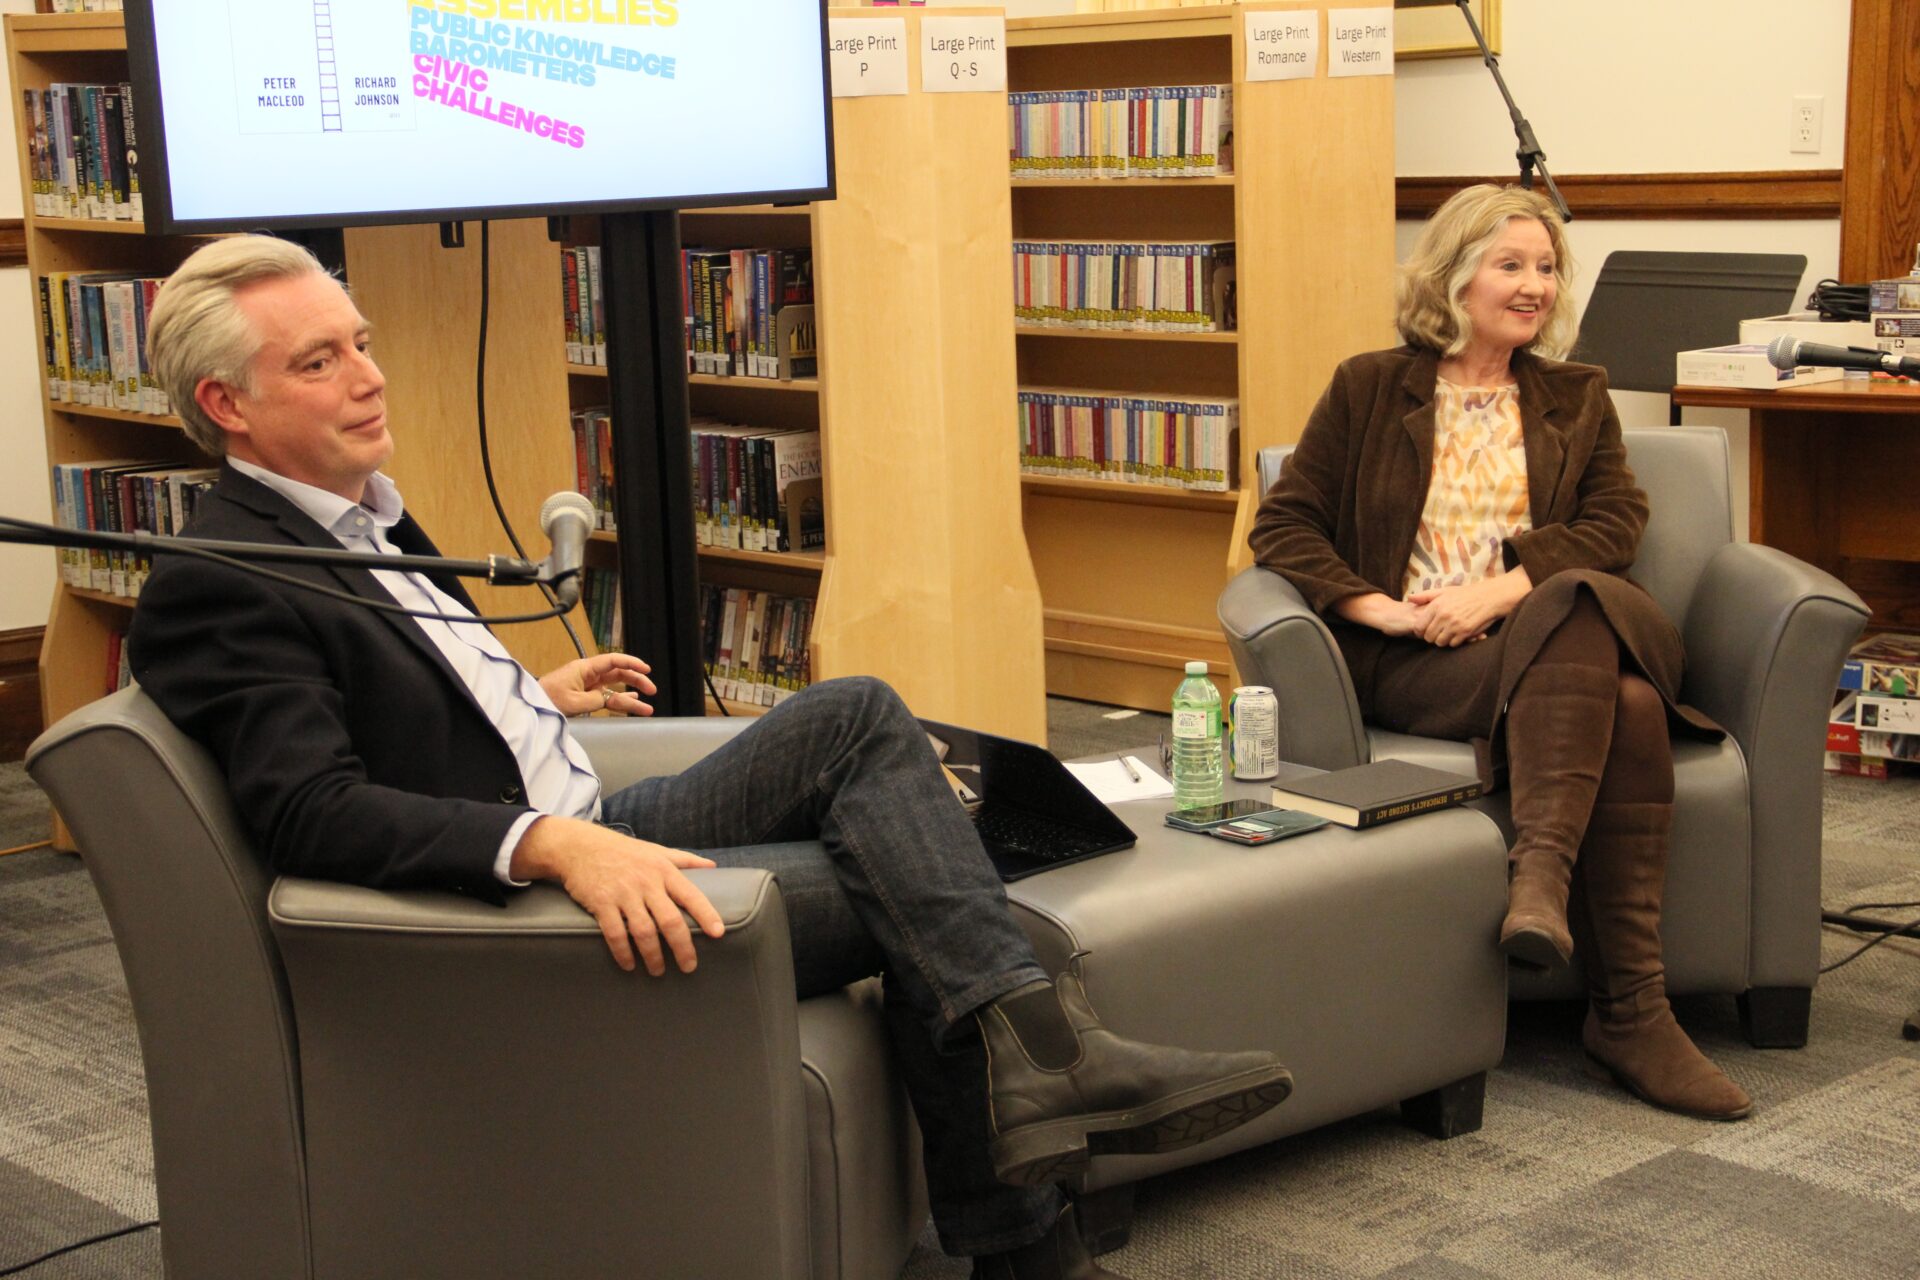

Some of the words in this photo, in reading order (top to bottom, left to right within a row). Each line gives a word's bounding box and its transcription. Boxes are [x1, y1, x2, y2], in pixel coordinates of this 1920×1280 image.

[1254, 28, 1283, 43] Large
[1286, 27, 1310, 39] Print
[1336, 27, 1362, 42] Large
[1366, 26, 1386, 38] Print
[412, 6, 511, 46] PUBLIC
[515, 27, 676, 79] KNOWLEDGE
[868, 36, 897, 50] Print
[931, 37, 964, 53] Large
[968, 37, 995, 50] Print
[410, 30, 596, 87] BAROMETERS
[1258, 51, 1306, 64] Romance
[1343, 50, 1381, 63] Western
[414, 54, 488, 91] CIVIC
[860, 63, 868, 77] P
[951, 62, 959, 79] Q
[970, 62, 977, 76] S
[264, 78, 296, 89] PETER
[355, 77, 396, 88] RICHARD
[258, 96, 304, 106] MACLEOD
[355, 94, 399, 106] JOHNSON
[413, 74, 585, 148] CHALLENGES
[577, 251, 586, 279] JAMES
[701, 259, 709, 282] JAMES
[714, 281, 722, 303] JAMES
[1412, 795, 1447, 808] DEMOCRACY'S
[1376, 811, 1387, 820] ACT
[1389, 805, 1410, 816] SECOND
